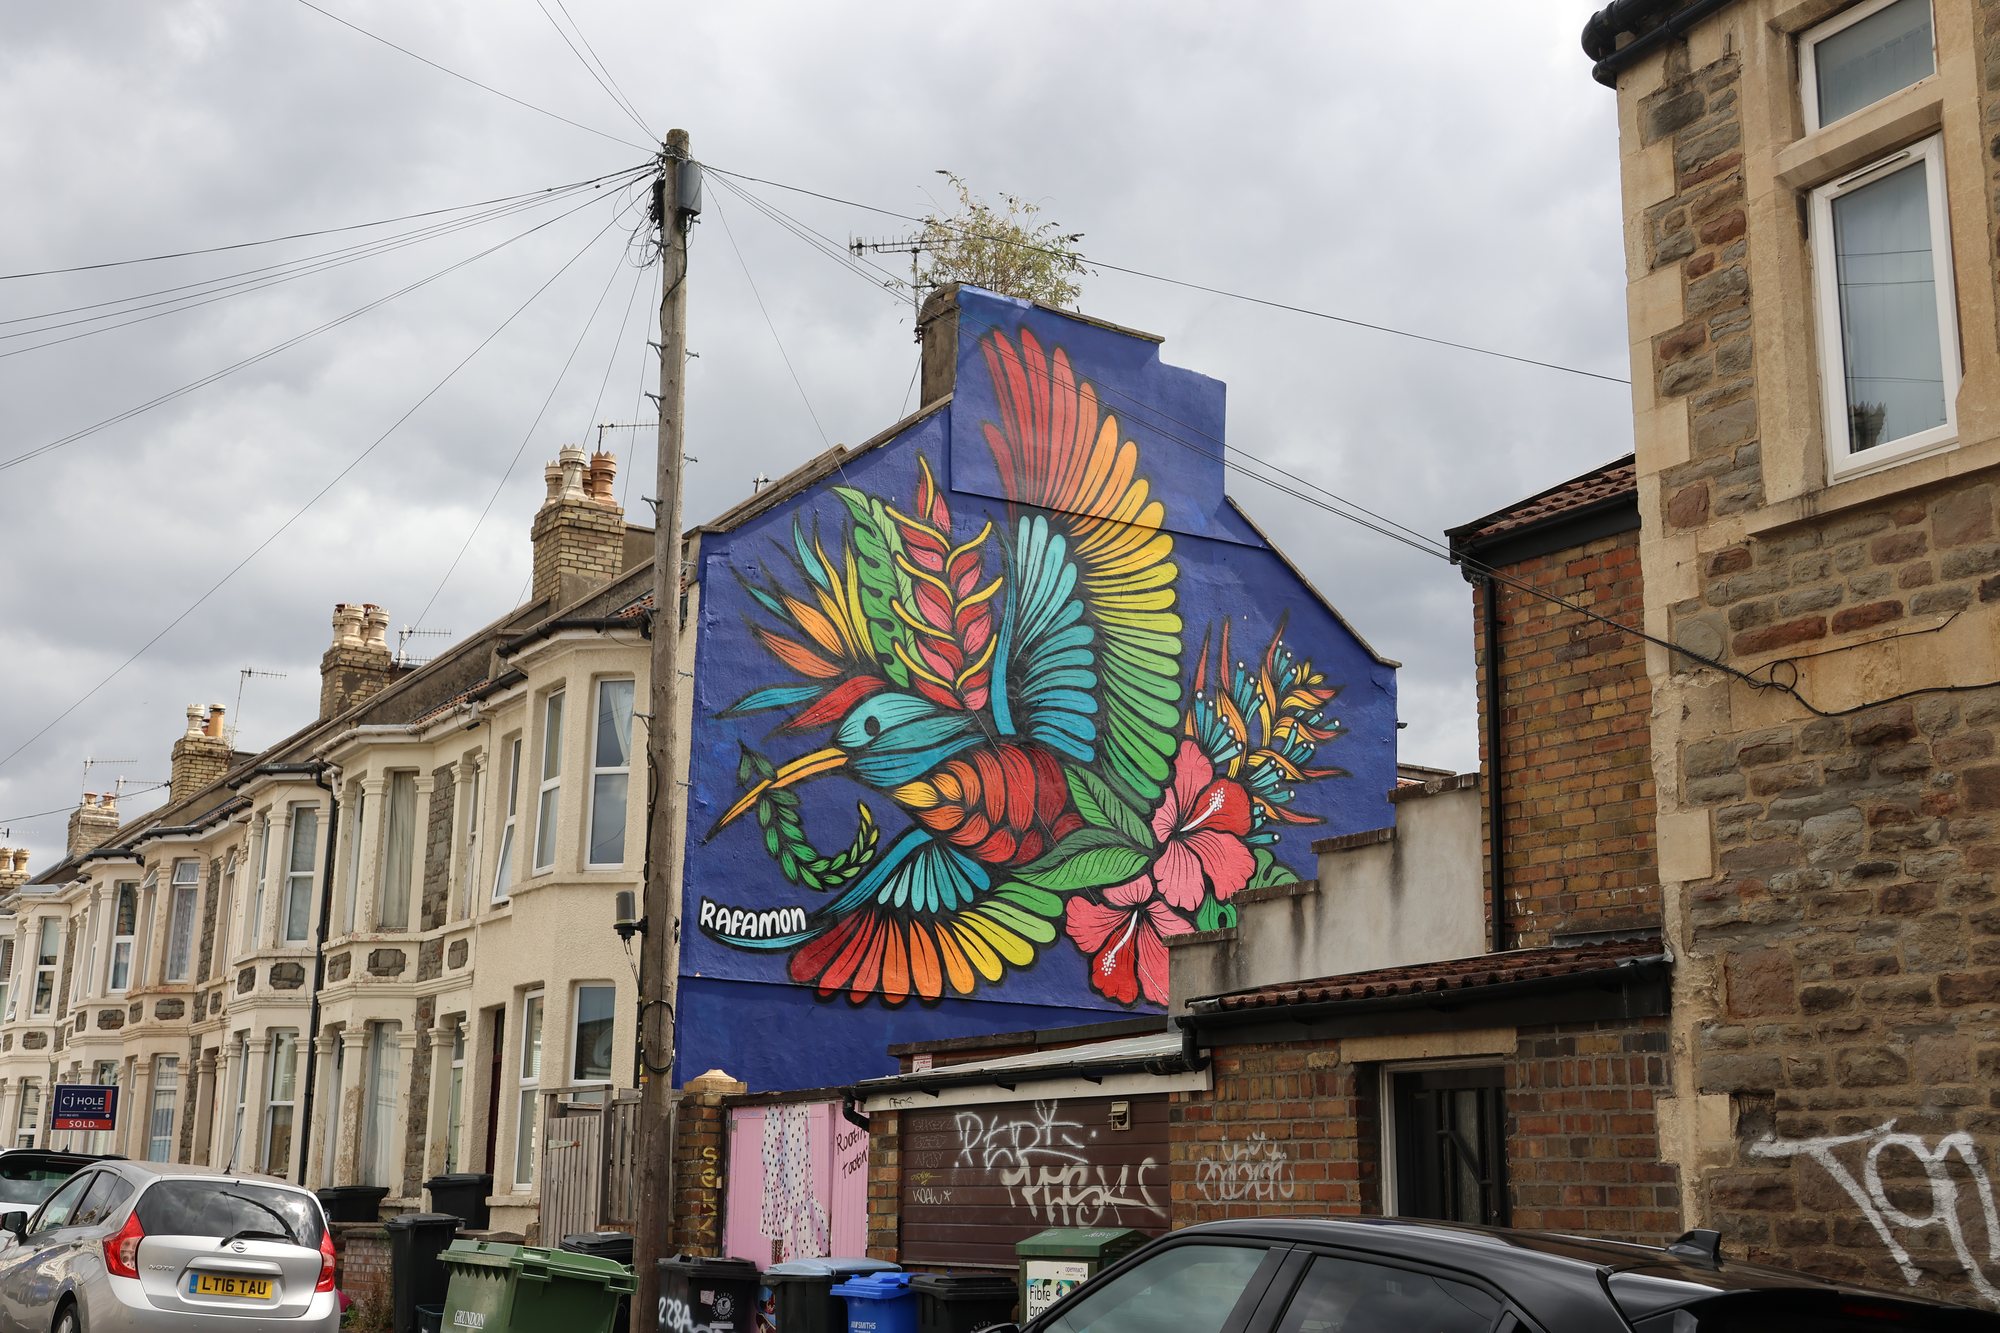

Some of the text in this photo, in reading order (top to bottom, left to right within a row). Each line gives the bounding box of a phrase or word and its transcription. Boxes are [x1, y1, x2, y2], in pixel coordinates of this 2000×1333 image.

[76, 1097, 105, 1106] HOLE
[68, 1120, 95, 1128] SOLD
[148, 1263, 176, 1273] NOTE
[201, 1276, 267, 1295] LT16 TAU
[1029, 1284, 1051, 1301] Fibre
[454, 1309, 486, 1327] GRUNDON
